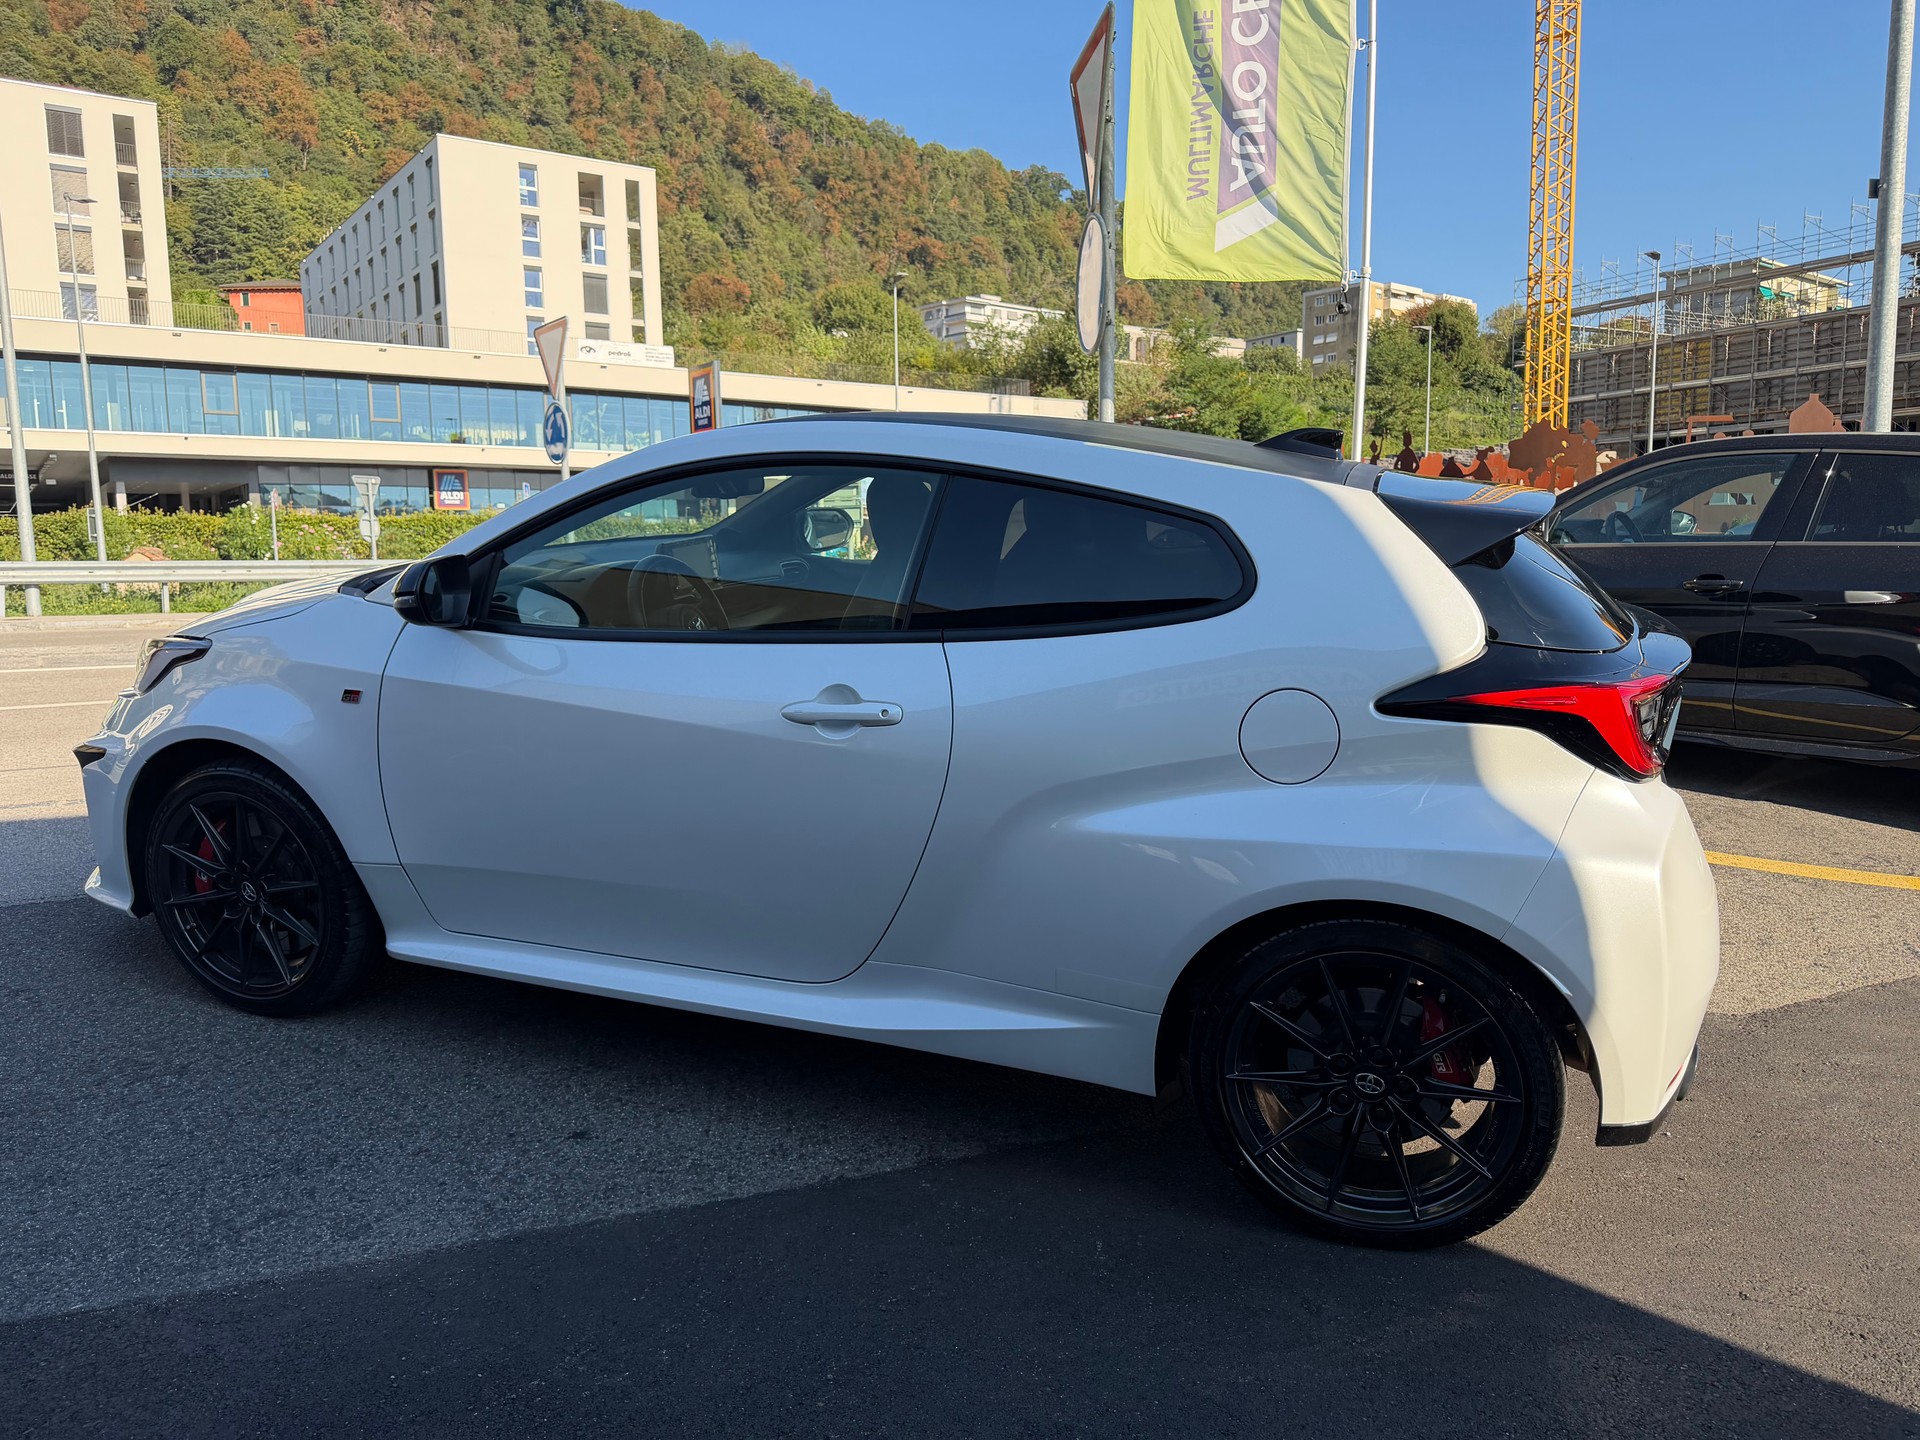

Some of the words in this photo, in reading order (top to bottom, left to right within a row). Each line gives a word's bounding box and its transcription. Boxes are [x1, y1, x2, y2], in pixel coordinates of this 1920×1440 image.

[695, 405, 711, 420] ALDI
[440, 491, 464, 500] ALDI
[342, 694, 359, 702] GR
[1433, 1052, 1446, 1072] GR
